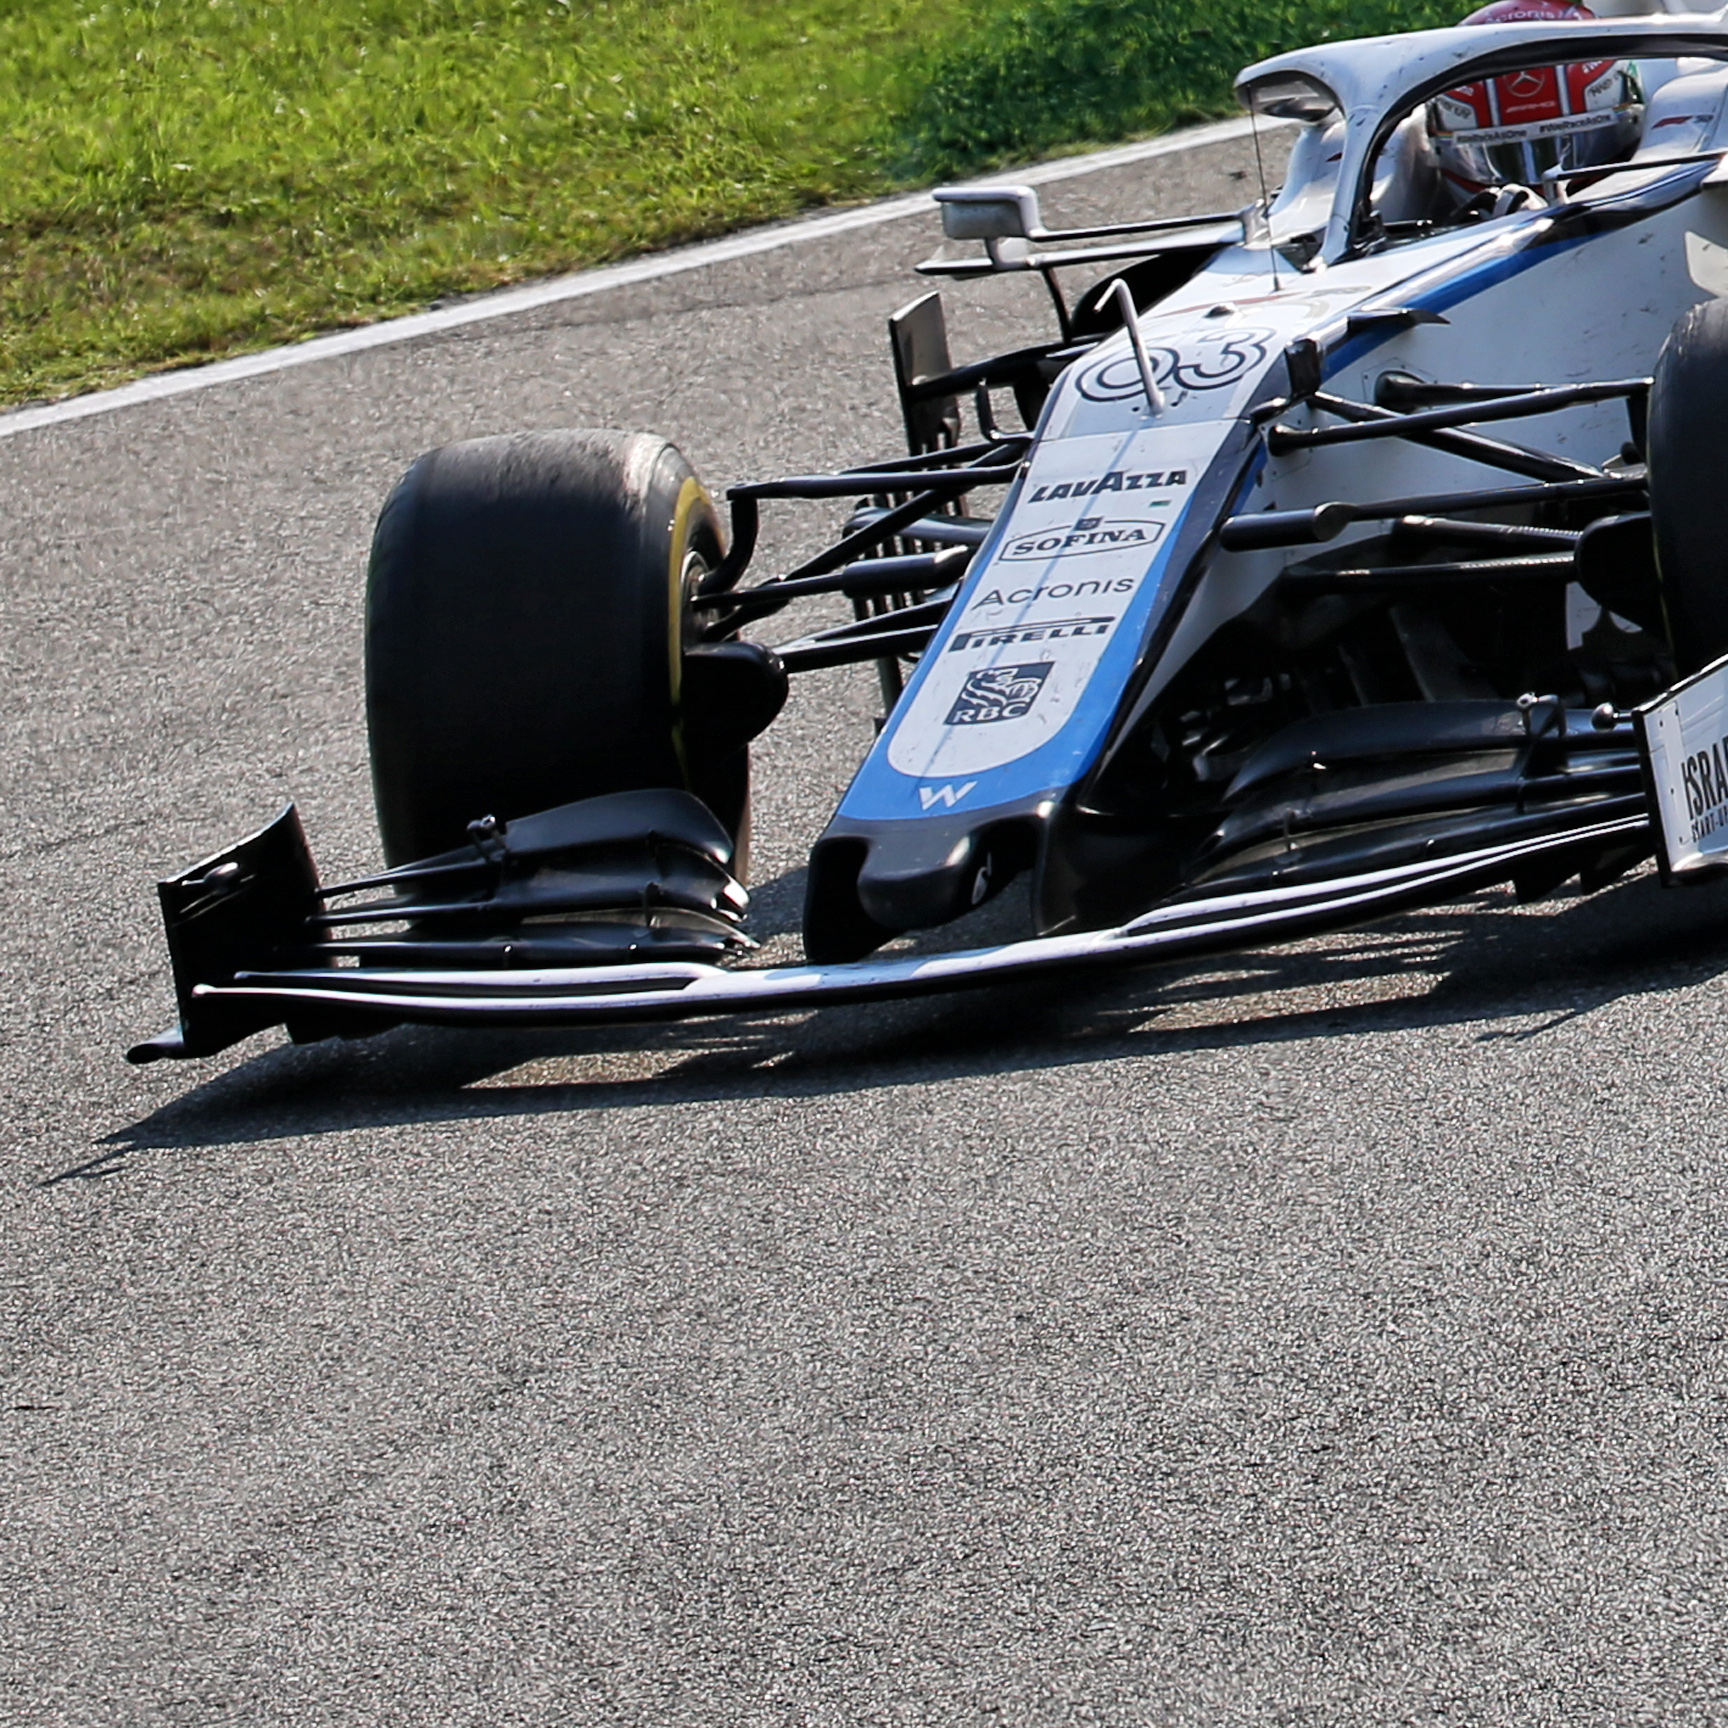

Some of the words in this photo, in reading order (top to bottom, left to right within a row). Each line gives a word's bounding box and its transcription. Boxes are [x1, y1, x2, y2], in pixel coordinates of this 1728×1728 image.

[1028, 470, 1188, 504] LAVAZZA
[1012, 526, 1148, 555] SOFINA
[971, 577, 1135, 611] Acronis
[948, 616, 1116, 653] PIRELLI
[951, 702, 1028, 723] RBC
[918, 780, 978, 811] W
